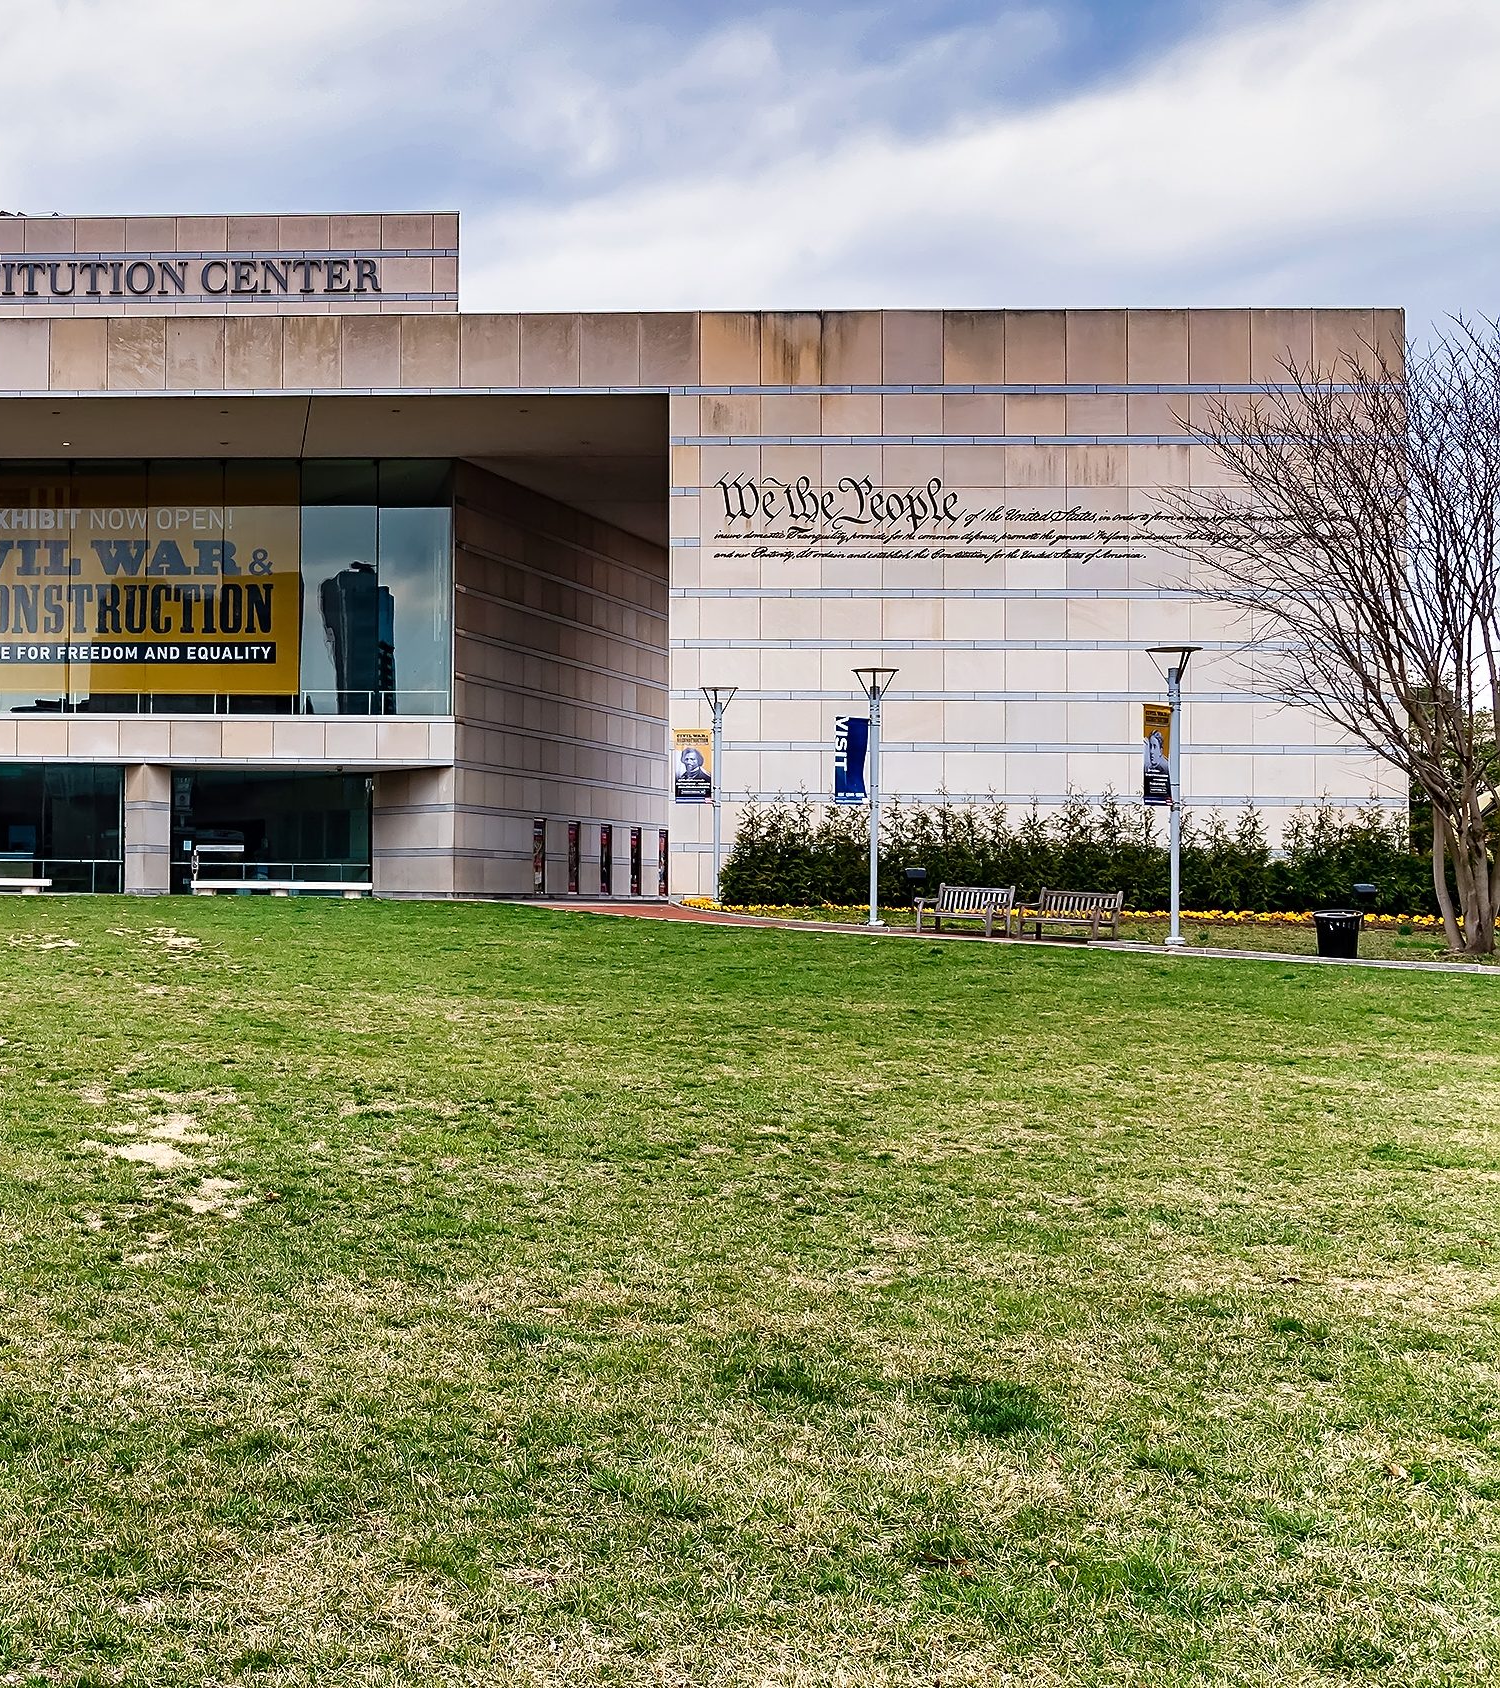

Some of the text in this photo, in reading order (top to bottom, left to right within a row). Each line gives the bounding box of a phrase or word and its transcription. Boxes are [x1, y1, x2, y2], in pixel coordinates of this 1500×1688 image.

[200, 259, 382, 294] CENTER
[90, 509, 146, 530] NOW
[157, 509, 234, 530] OPEN!
[713, 472, 785, 526] We
[781, 476, 844, 526] the
[832, 475, 967, 533] People
[964, 508, 986, 527] of
[981, 506, 1004, 521] the
[1005, 509, 1053, 521] United
[1050, 505, 1097, 523] States,
[91, 540, 242, 576] WAR
[248, 548, 274, 576] &
[17, 646, 50, 660] FOR
[57, 646, 138, 660] FREEDOM
[144, 646, 180, 660] AND
[187, 646, 271, 661] EQUALITY
[835, 717, 849, 771] VISIT
